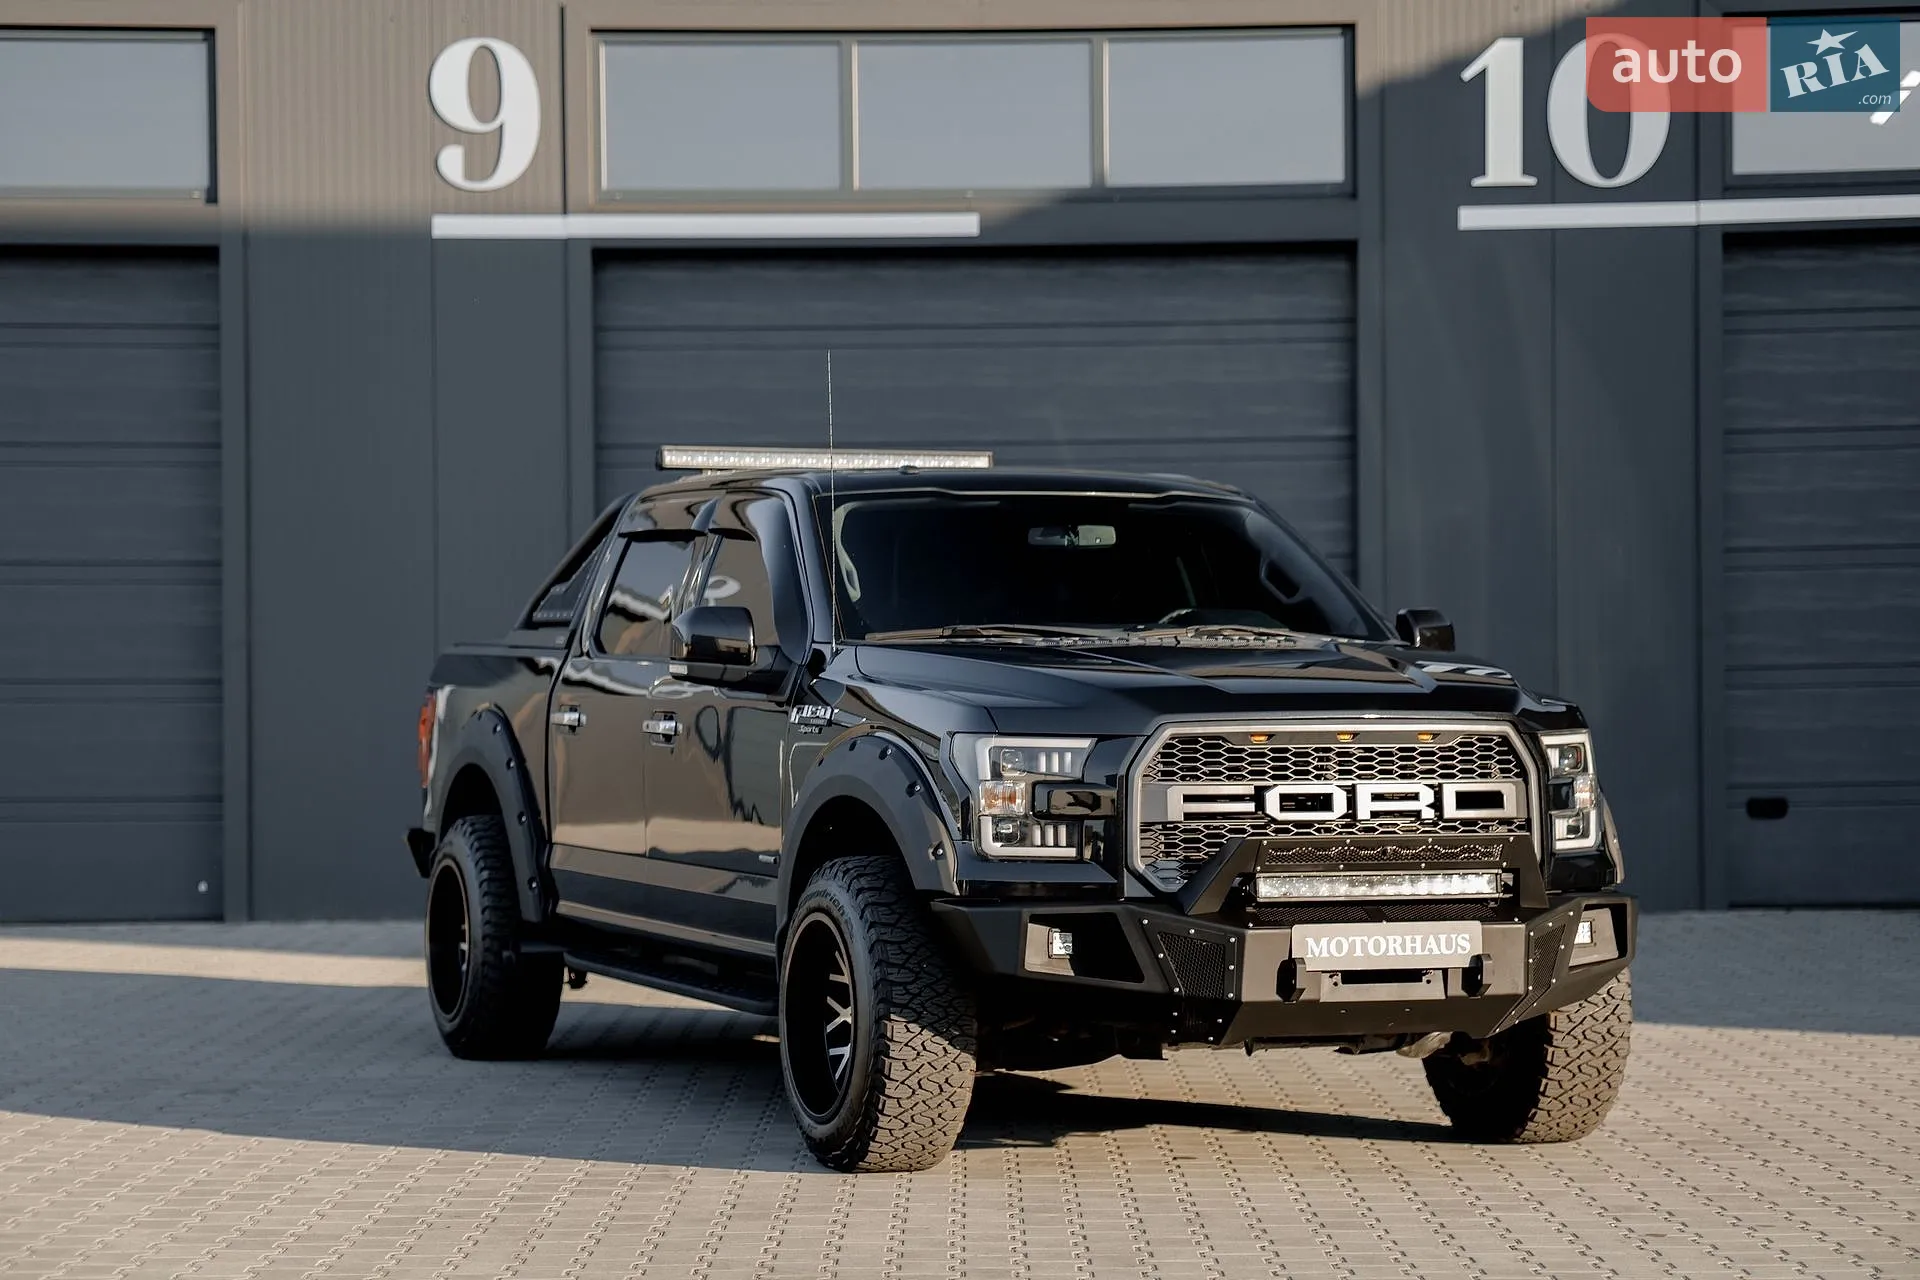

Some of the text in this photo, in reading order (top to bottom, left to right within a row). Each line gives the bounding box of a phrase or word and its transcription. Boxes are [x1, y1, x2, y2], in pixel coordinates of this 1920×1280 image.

[429, 36, 541, 192] 9
[1460, 32, 1671, 188] 10
[1167, 783, 1516, 821] FORD
[1305, 933, 1471, 958] MOTORHAUS
